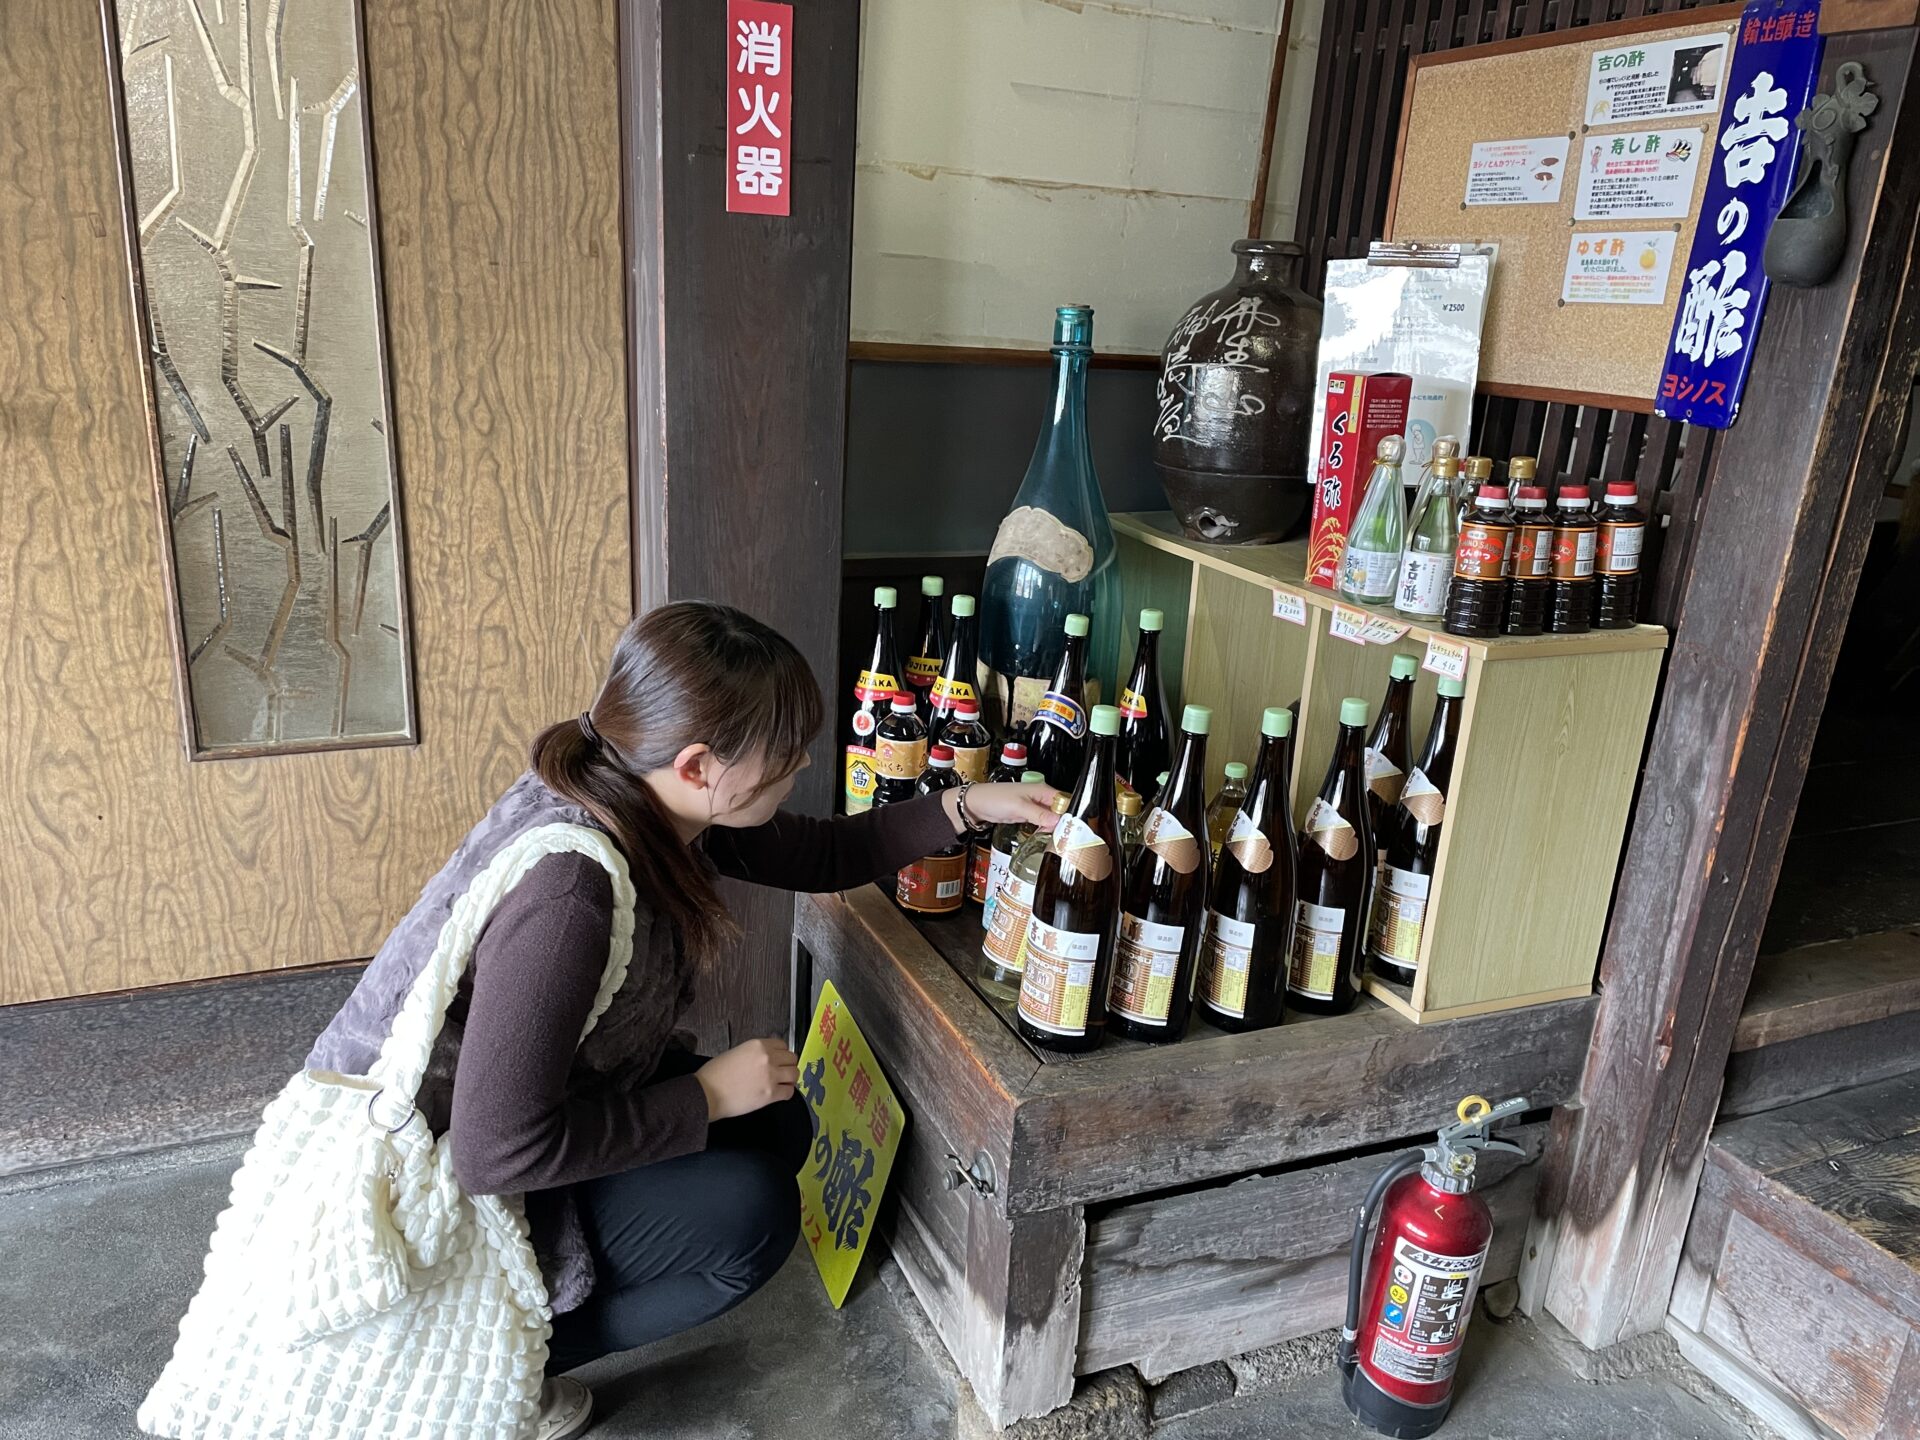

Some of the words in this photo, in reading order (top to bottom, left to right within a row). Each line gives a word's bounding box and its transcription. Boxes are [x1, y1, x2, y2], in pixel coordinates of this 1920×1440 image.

[1743, 12, 1815, 46] 輸出醸造
[1598, 50, 1645, 72] 吉の酢
[736, 20, 782, 196] 消火器
[1611, 135, 1661, 155] 寿し酢
[1675, 71, 1790, 367] 吉の酢
[1577, 238, 1625, 256] ゆず酢
[1660, 373, 1725, 406] ヨシノス
[1323, 411, 1349, 510] くろ酢
[1459, 549, 1490, 561] とんかつ
[1402, 560, 1421, 603] 吉の酢
[853, 769, 870, 787] 高
[818, 1003, 892, 1148] 輸出醸造
[1424, 1276, 1430, 1284] 1
[1419, 1298, 1427, 1306] 2
[1413, 1321, 1421, 1329] 3
